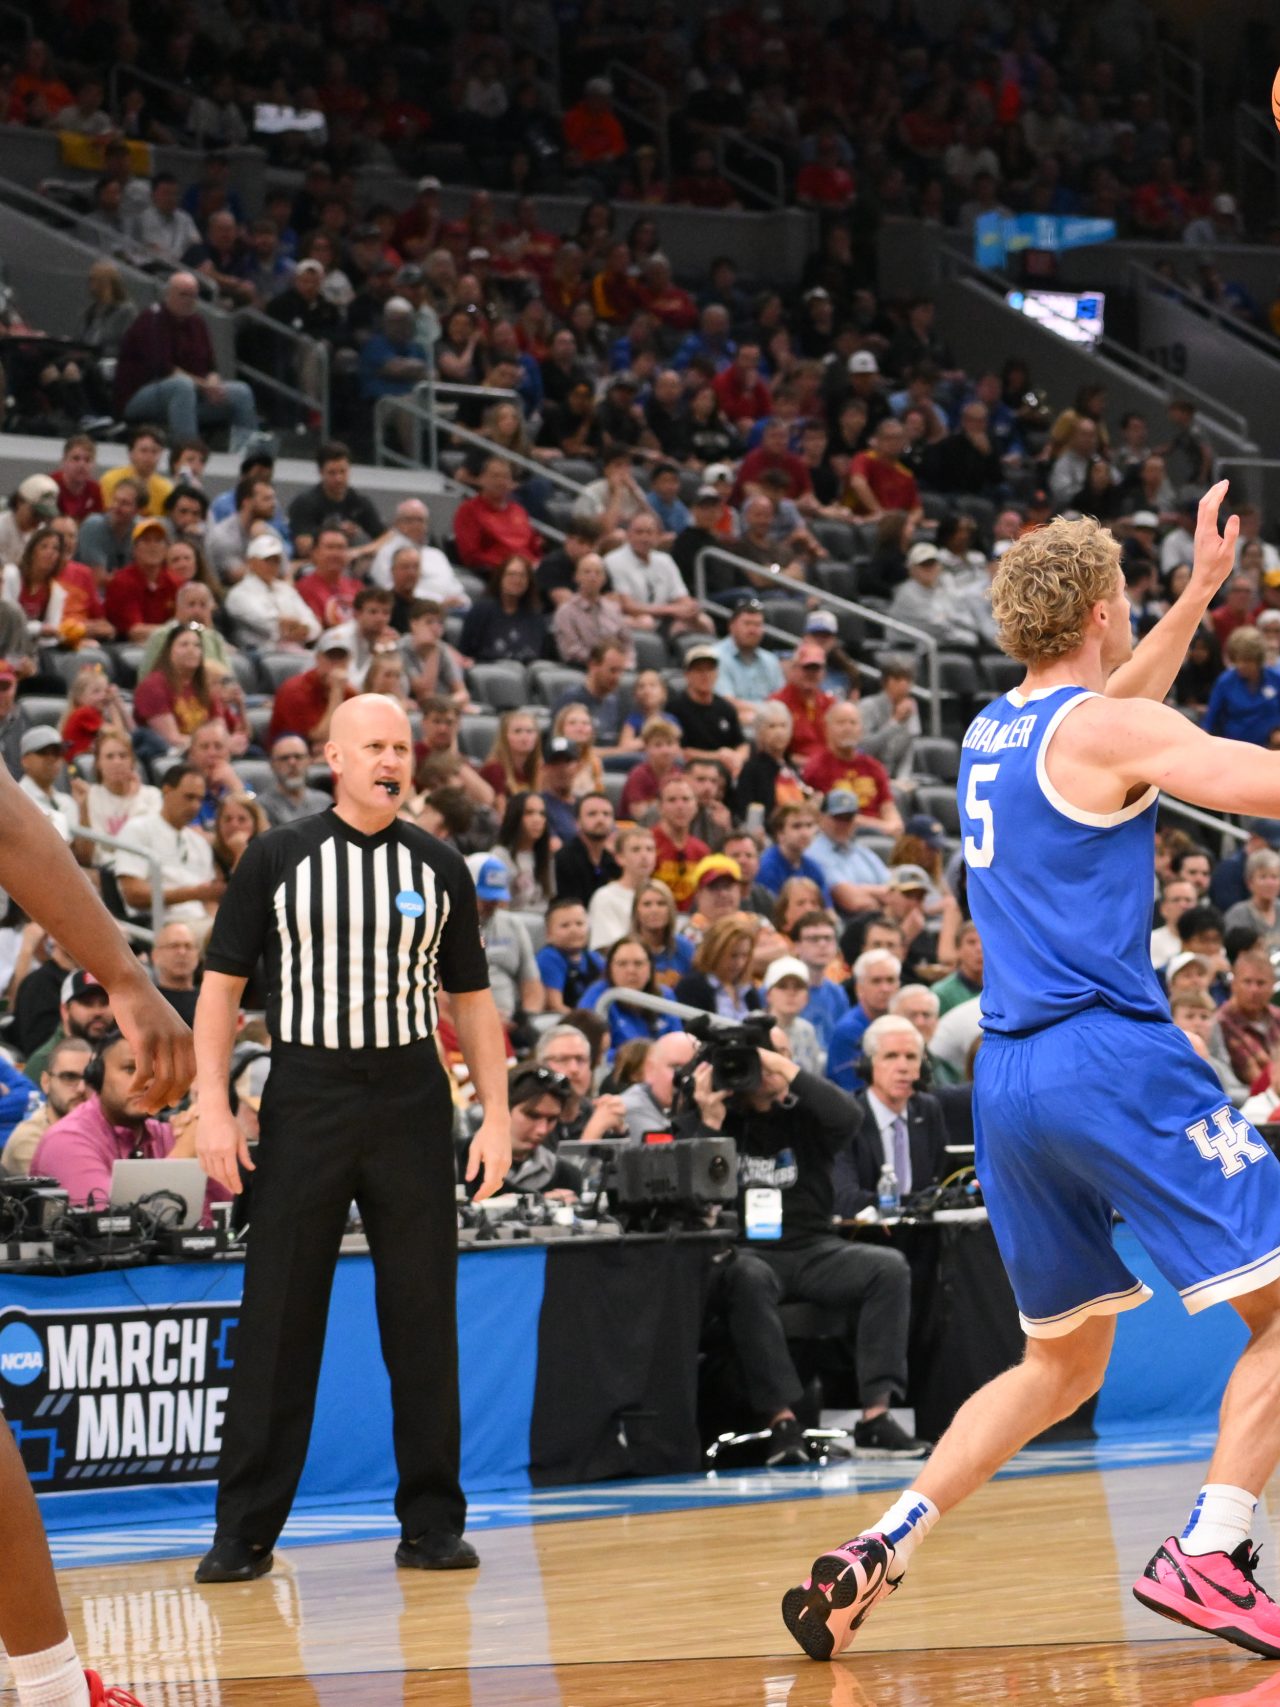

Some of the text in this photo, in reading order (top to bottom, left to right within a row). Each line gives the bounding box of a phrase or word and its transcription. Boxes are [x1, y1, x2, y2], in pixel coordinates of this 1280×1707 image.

[964, 763, 1000, 868] 5
[1185, 1105, 1268, 1179] UK
[1, 1352, 43, 1371] NCAA
[47, 1317, 209, 1391] MARCH
